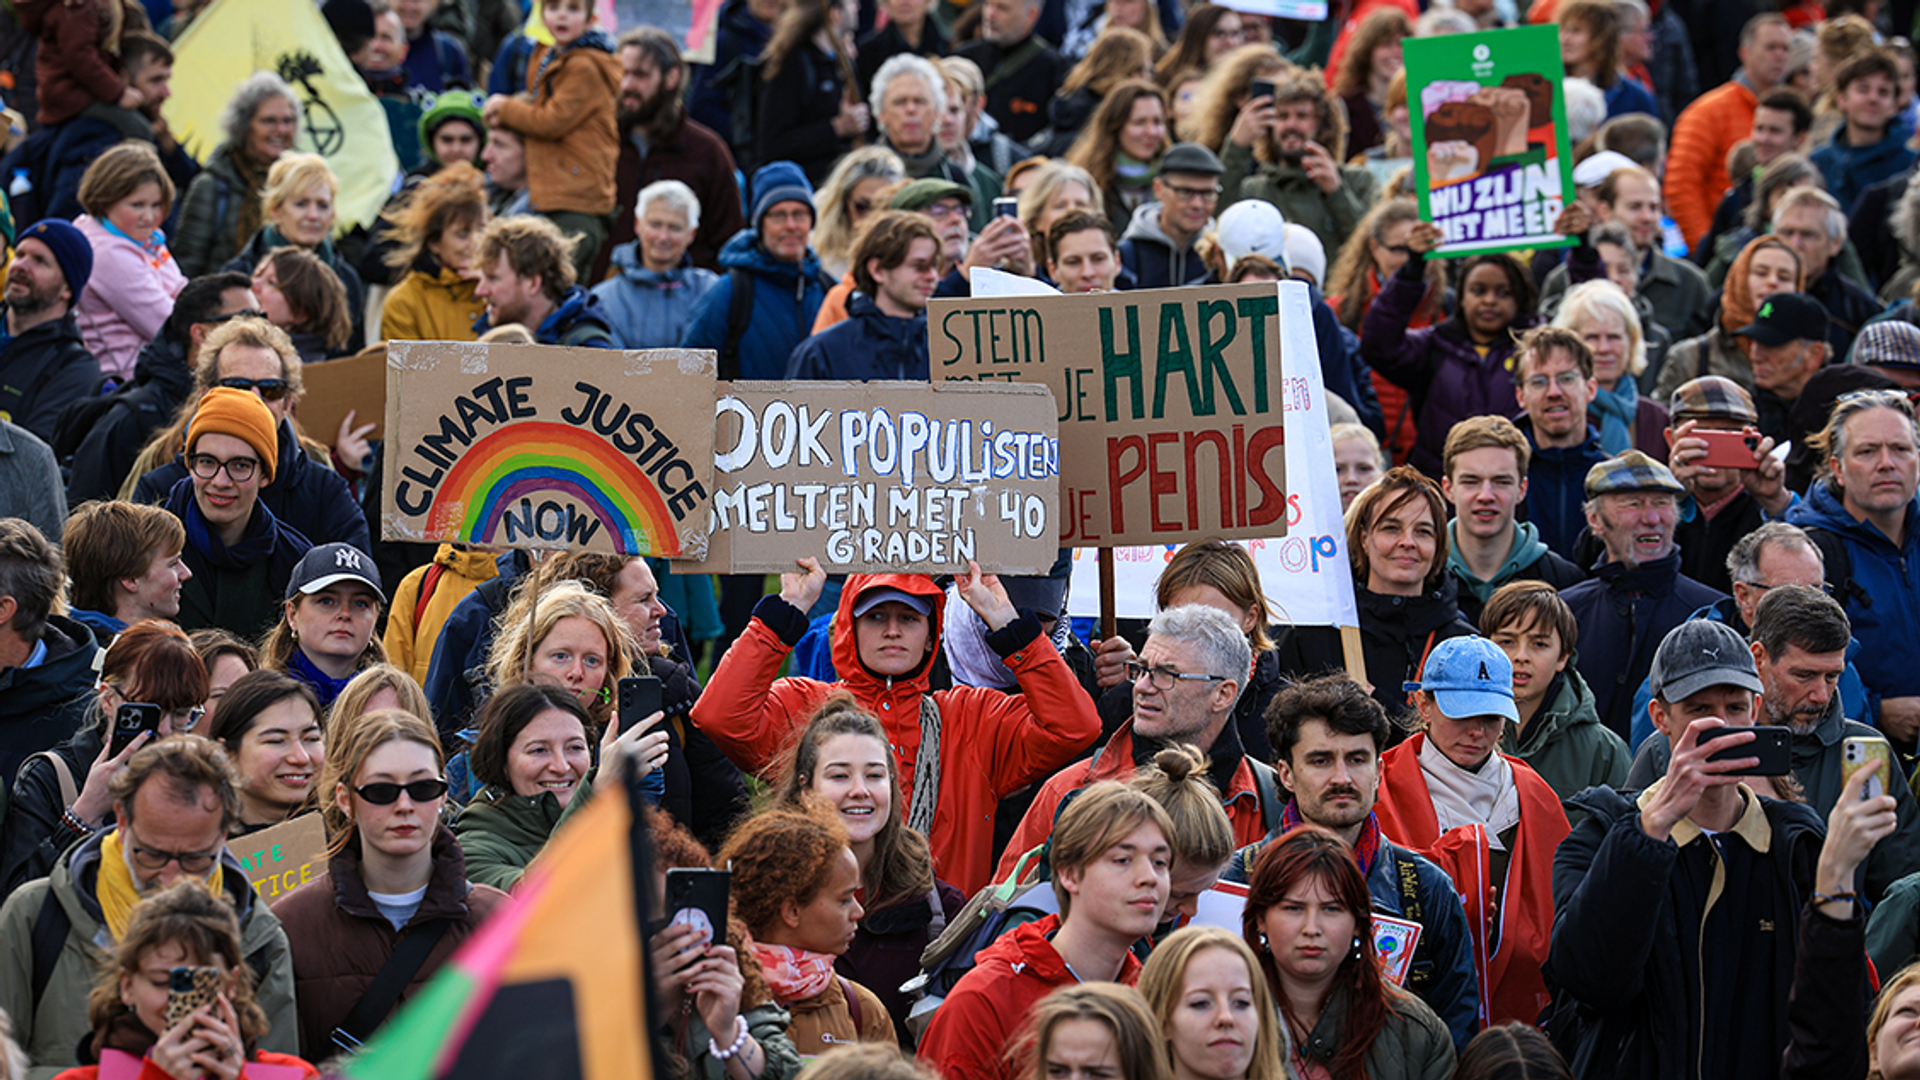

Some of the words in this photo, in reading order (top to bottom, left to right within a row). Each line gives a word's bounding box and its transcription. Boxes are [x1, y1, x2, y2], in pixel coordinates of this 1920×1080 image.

[1429, 181, 1472, 217] WIJ
[1473, 160, 1562, 210] ZIJN
[943, 308, 1045, 366] STEM
[1059, 367, 1097, 422] JE
[1098, 295, 1279, 422] HART
[395, 377, 537, 517] CLIMATE
[560, 381, 707, 522] JUSTICE
[714, 395, 833, 474] OOK
[709, 481, 876, 536] MELTEN
[888, 487, 970, 532] MET
[999, 490, 1046, 539] 40
[1059, 488, 1100, 541] JE
[1107, 424, 1287, 534] PENIS
[503, 498, 601, 546] NOW
[826, 527, 977, 565] GRADEN
[335, 548, 361, 570] NY
[1477, 660, 1490, 680] A
